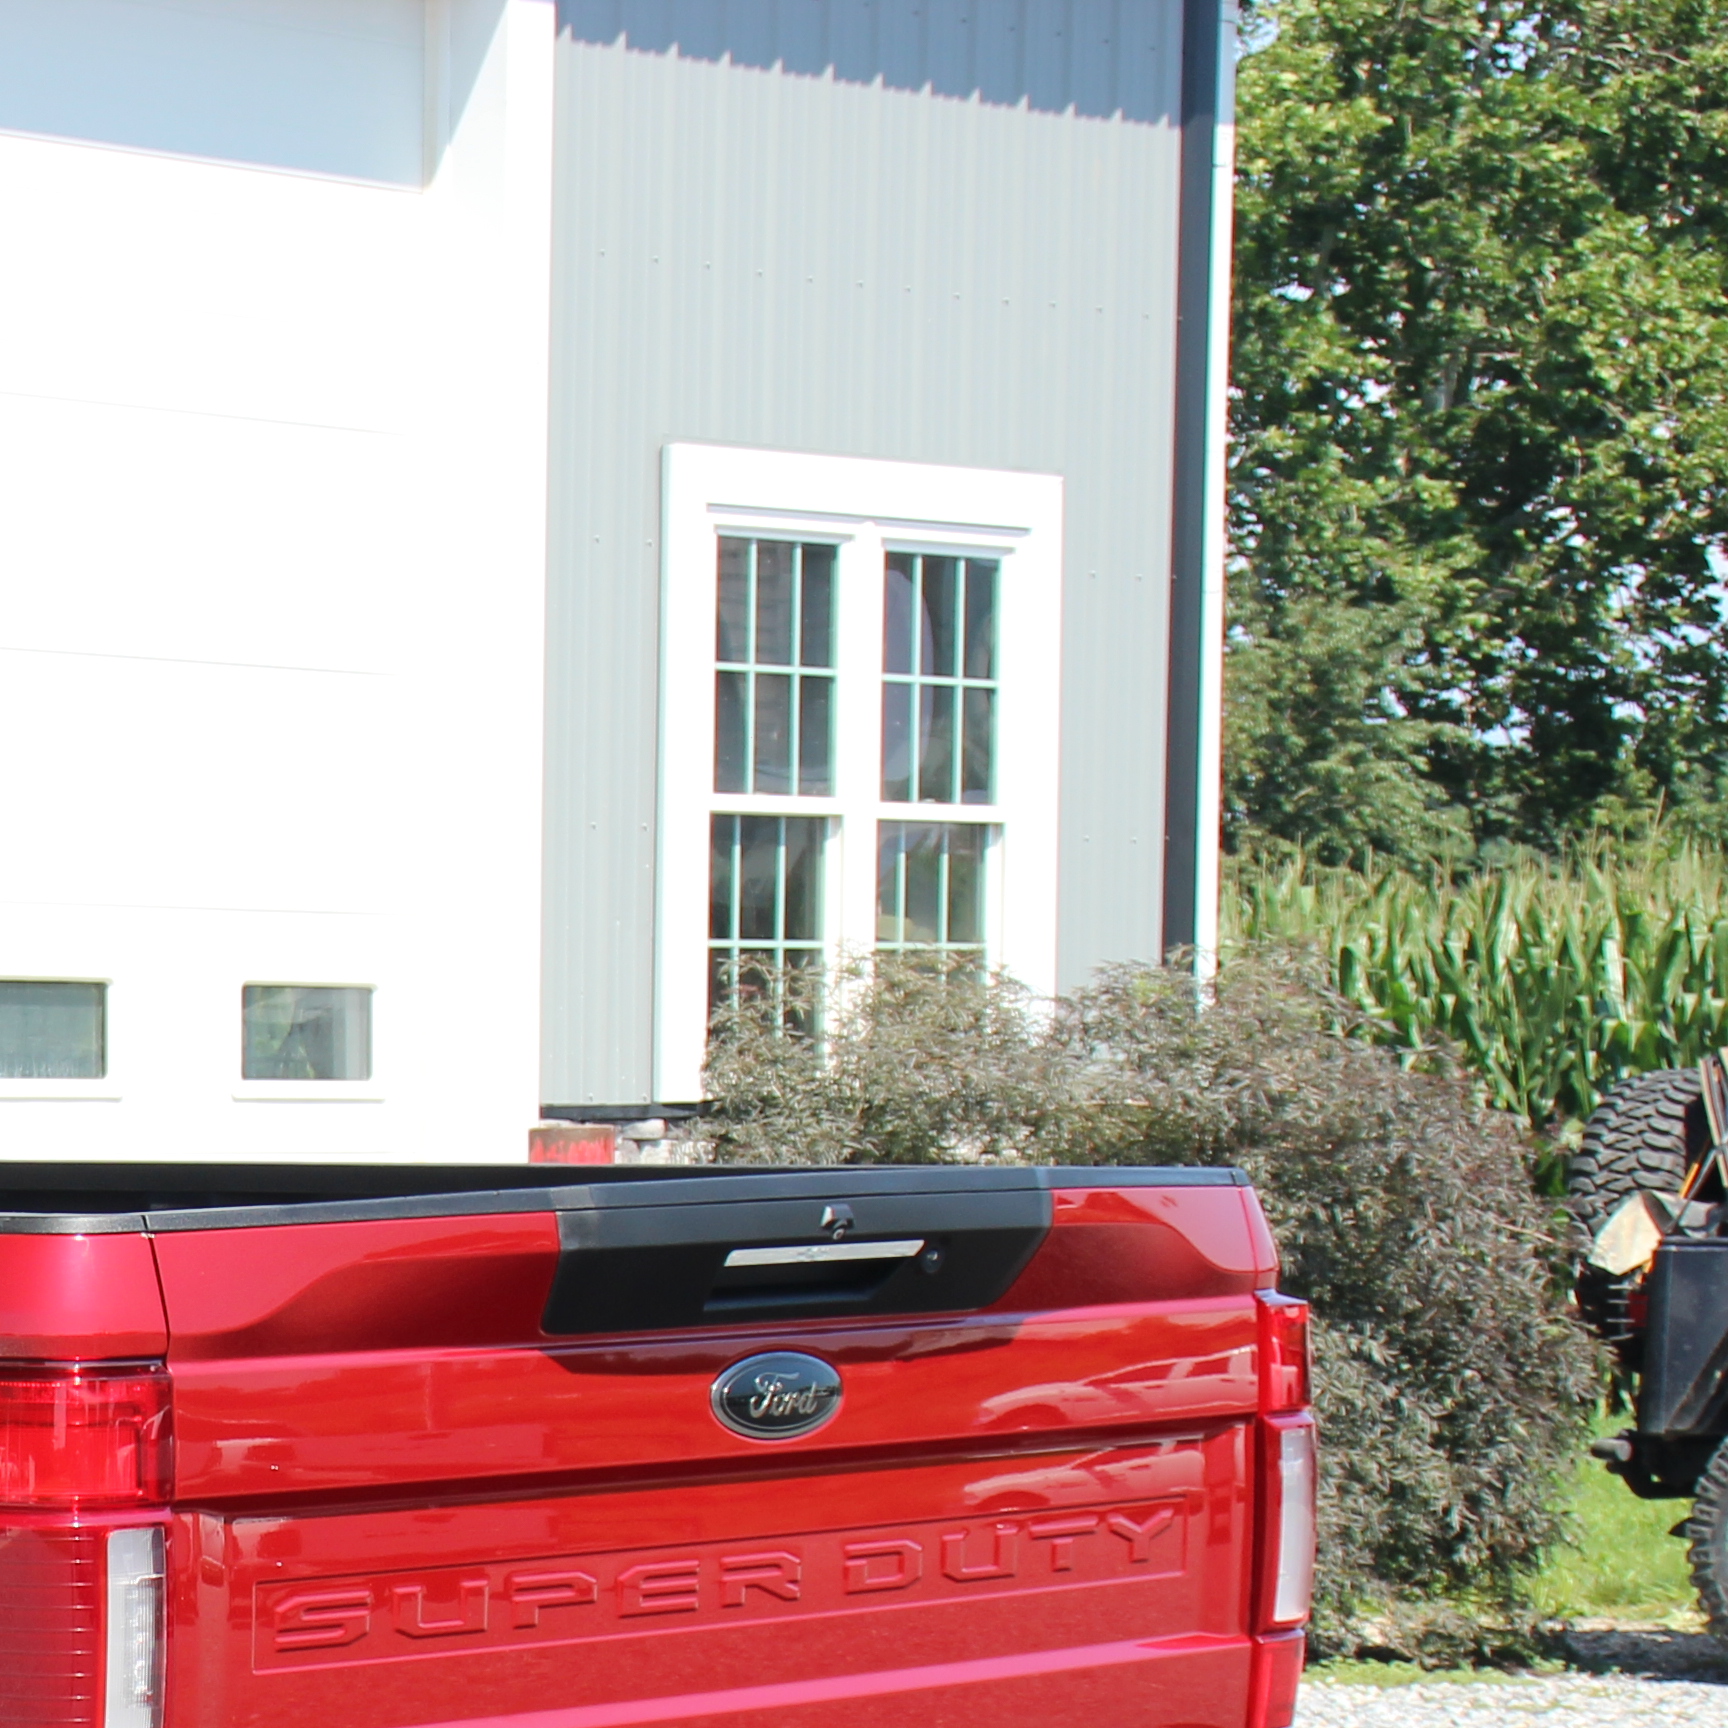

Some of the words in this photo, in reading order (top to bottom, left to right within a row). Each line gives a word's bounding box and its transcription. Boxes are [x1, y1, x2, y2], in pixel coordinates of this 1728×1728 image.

[749, 1372, 818, 1419] Ford
[274, 1550, 801, 1654] SUPER
[843, 1505, 1176, 1597] DUTY
